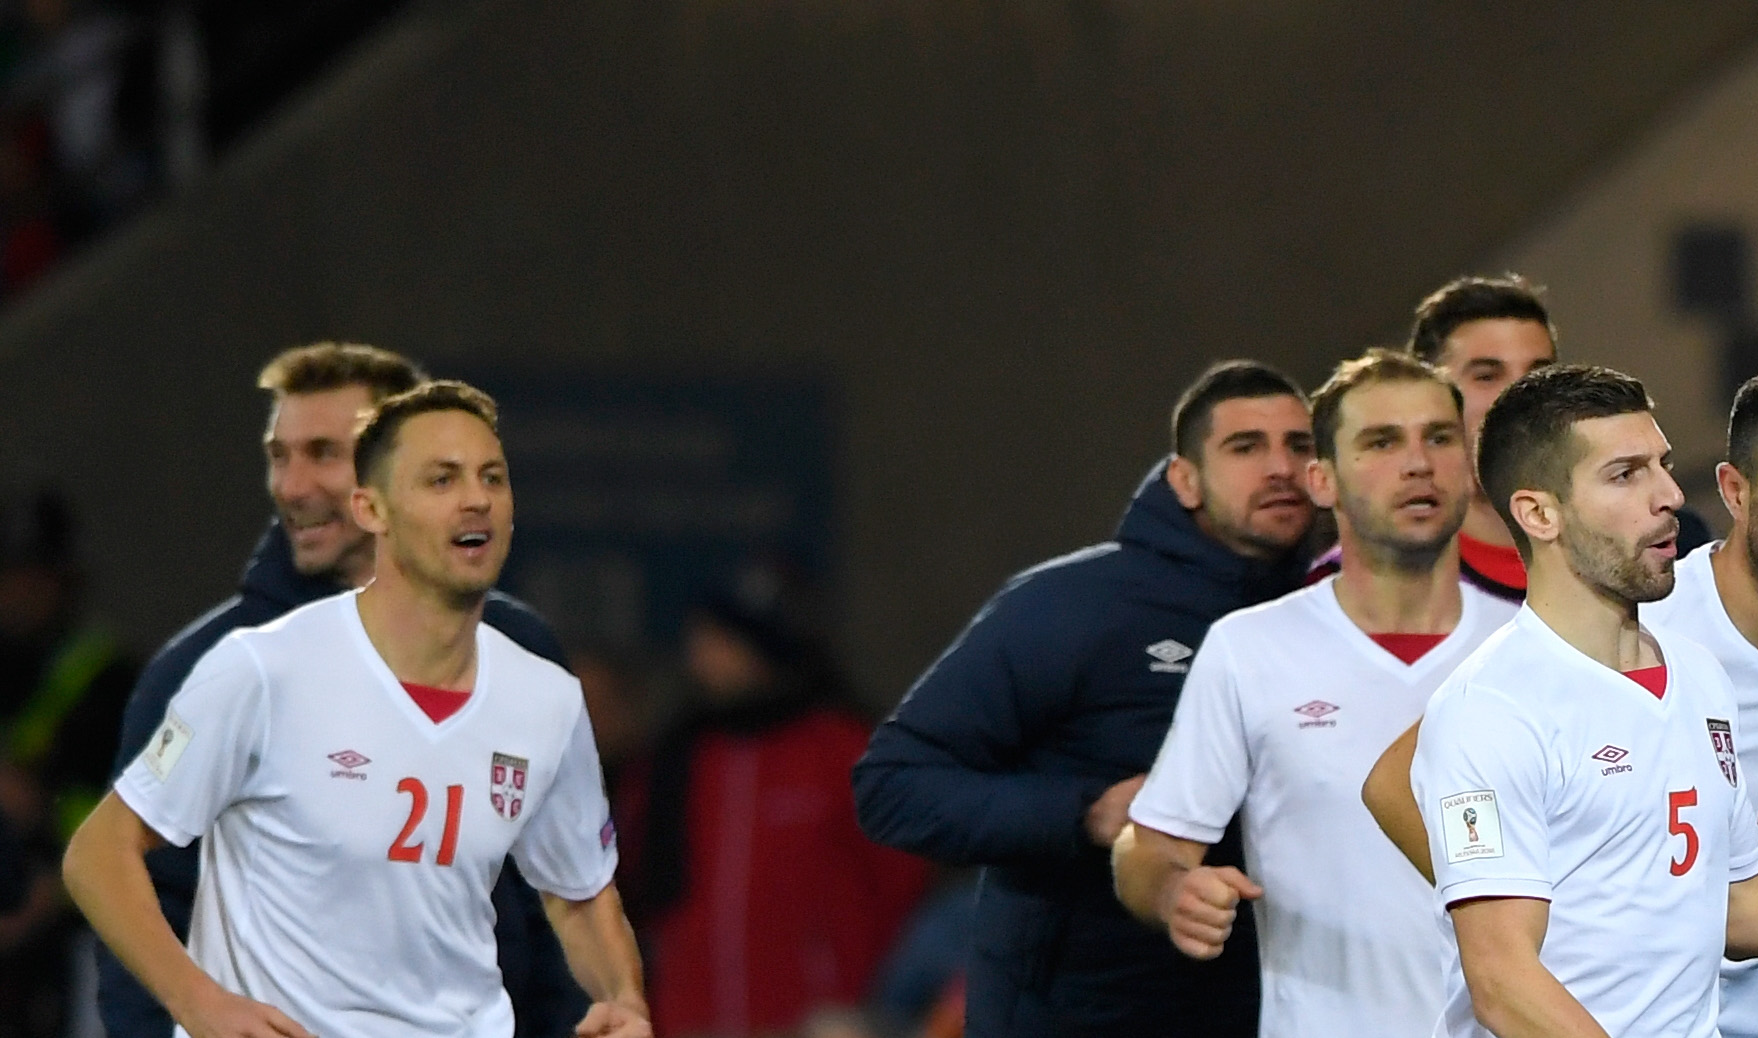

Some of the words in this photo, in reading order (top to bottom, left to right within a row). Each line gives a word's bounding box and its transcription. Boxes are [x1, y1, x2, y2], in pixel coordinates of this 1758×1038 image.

[1602, 764, 1633, 776] umbro
[387, 776, 464, 867] 21
[1668, 786, 1699, 877] 5
